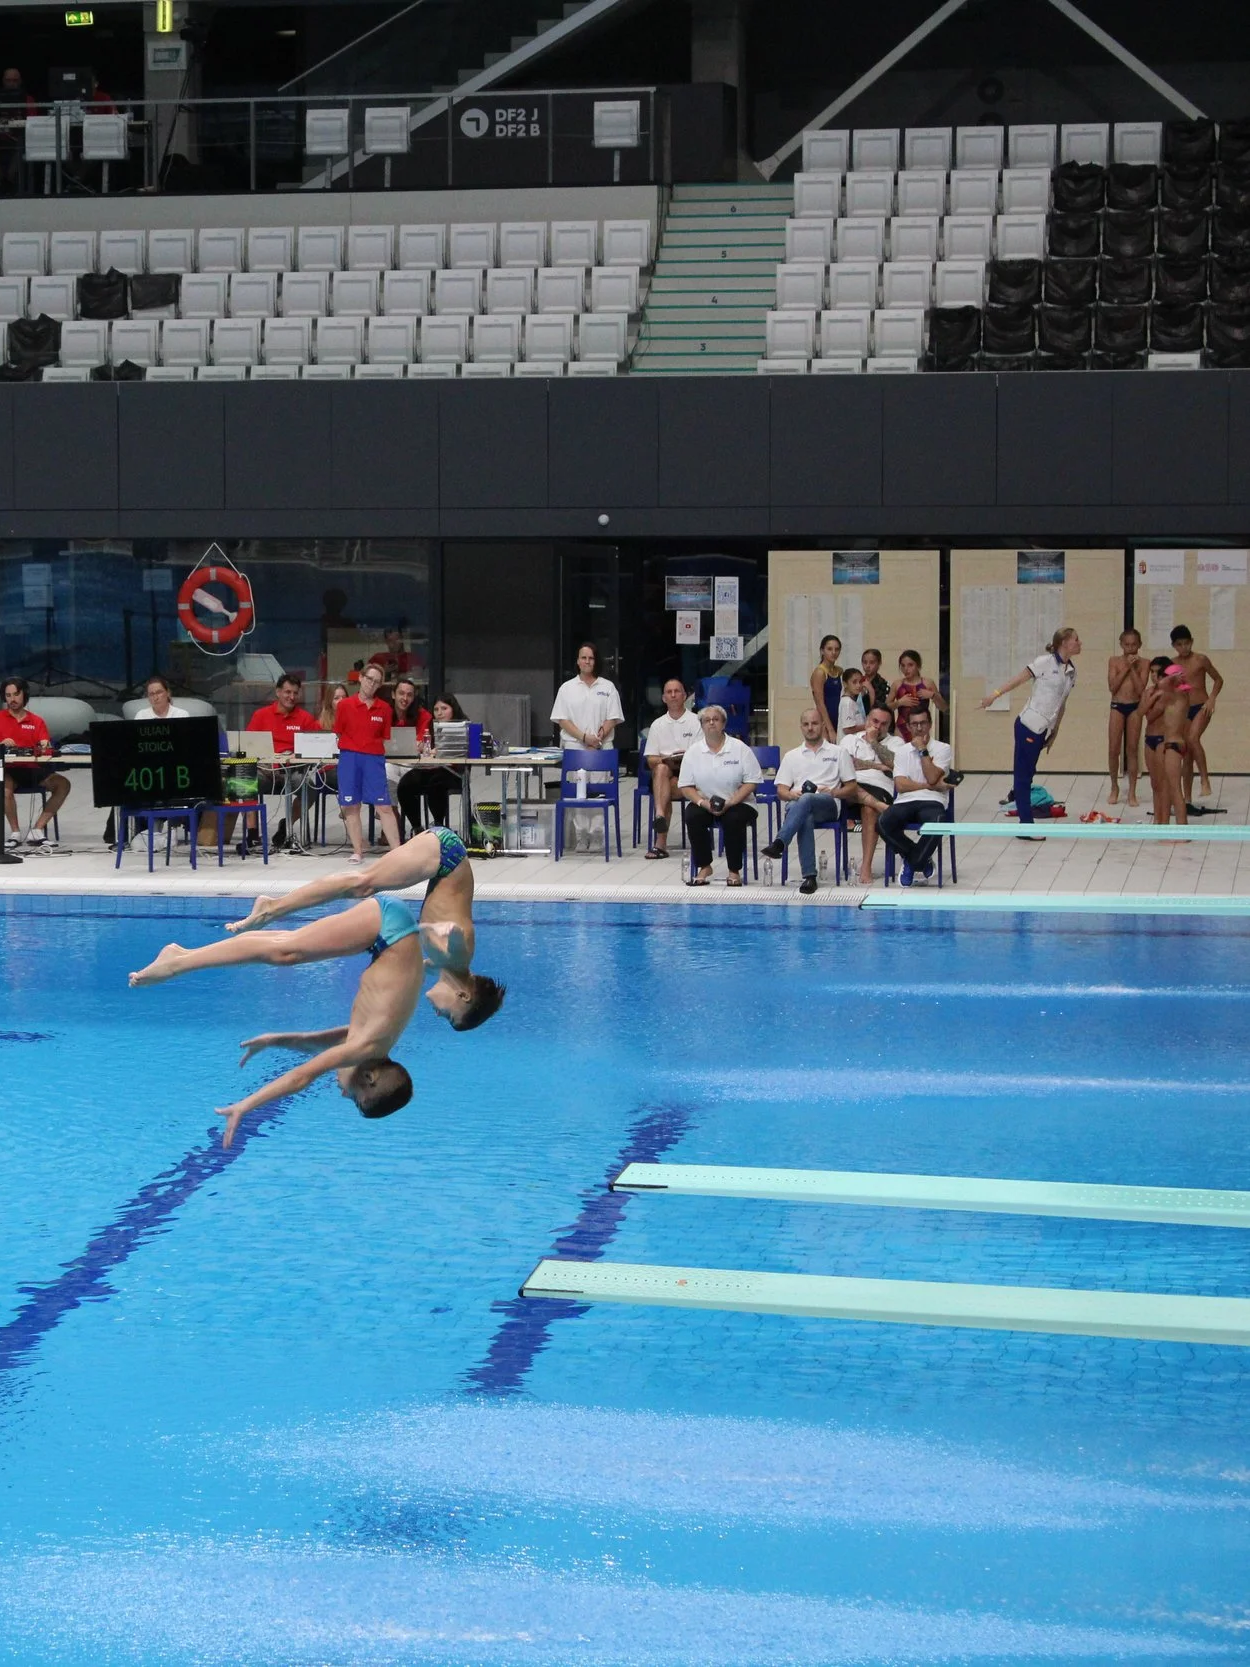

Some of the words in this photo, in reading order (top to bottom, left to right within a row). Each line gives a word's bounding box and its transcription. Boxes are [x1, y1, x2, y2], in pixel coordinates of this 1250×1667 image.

[495, 108, 527, 121] DF2
[531, 108, 538, 121] J
[495, 124, 527, 137] DF2
[530, 123, 541, 137] B
[137, 741, 174, 753] STOICA
[124, 766, 165, 791] 401
[176, 765, 190, 789] B
